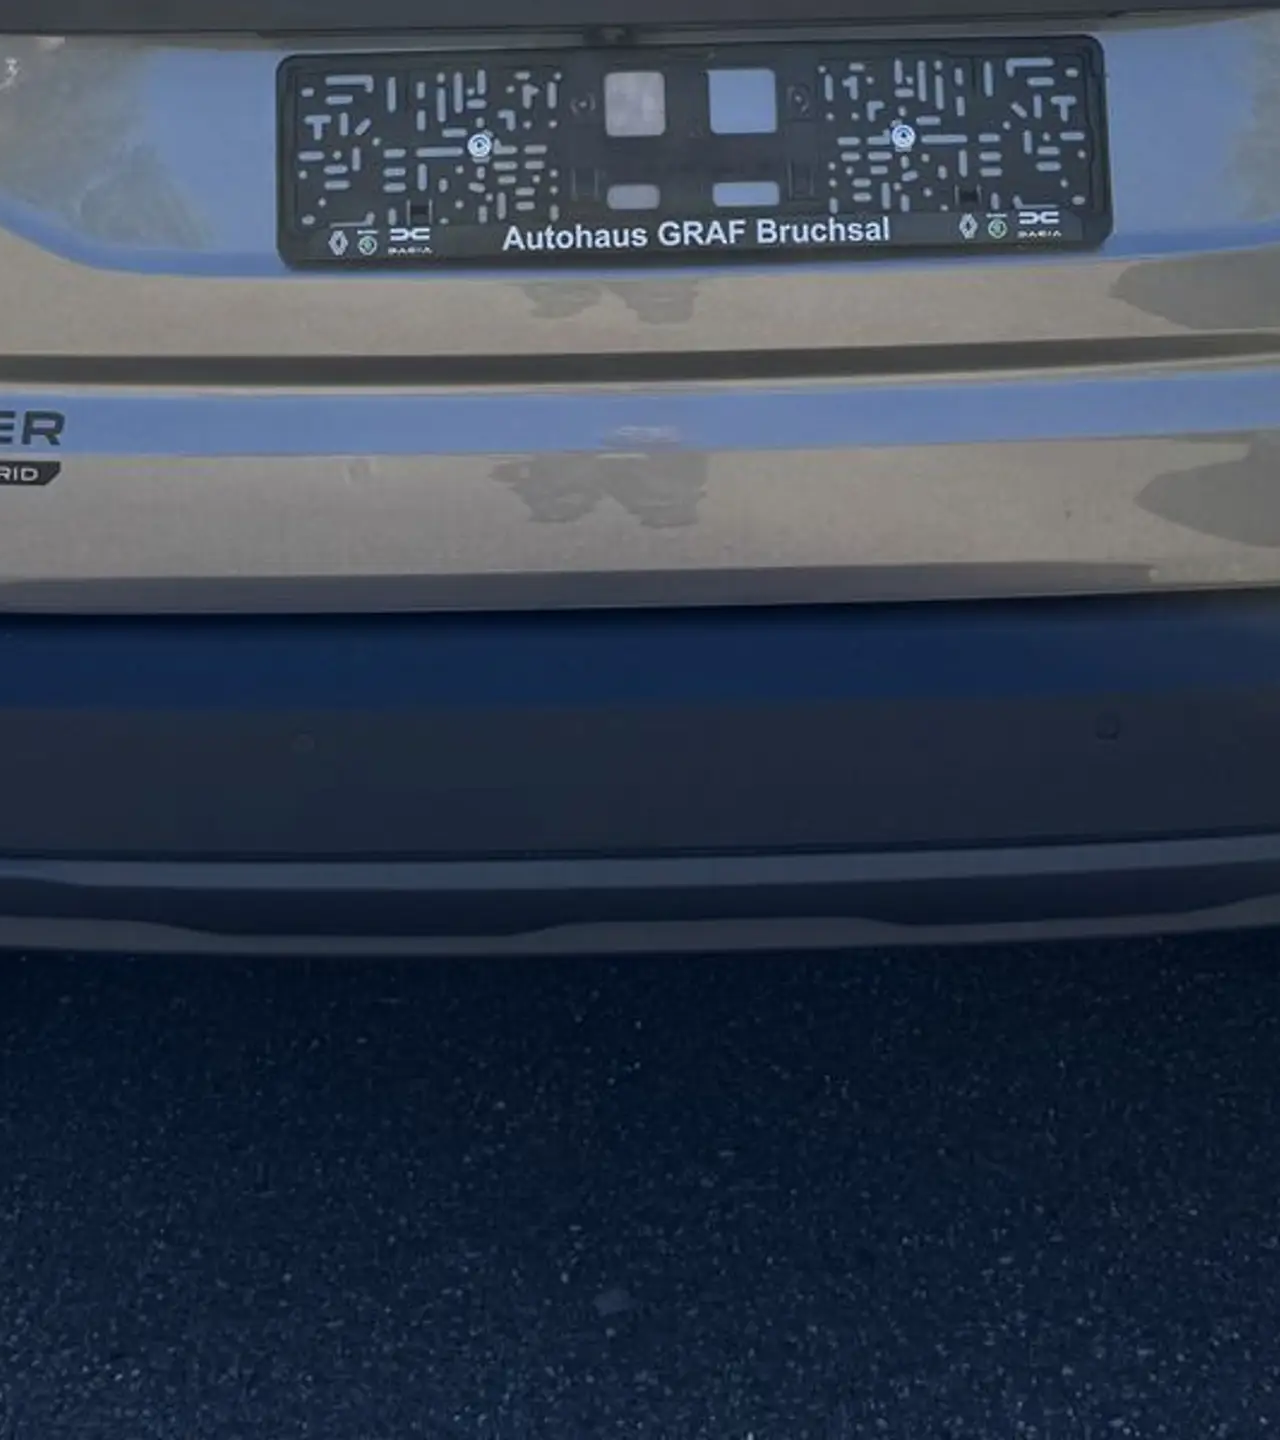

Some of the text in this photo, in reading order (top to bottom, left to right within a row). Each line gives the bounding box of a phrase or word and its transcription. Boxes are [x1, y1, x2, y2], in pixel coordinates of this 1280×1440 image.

[502, 216, 890, 251] Autohaus GRAF Bruchsal
